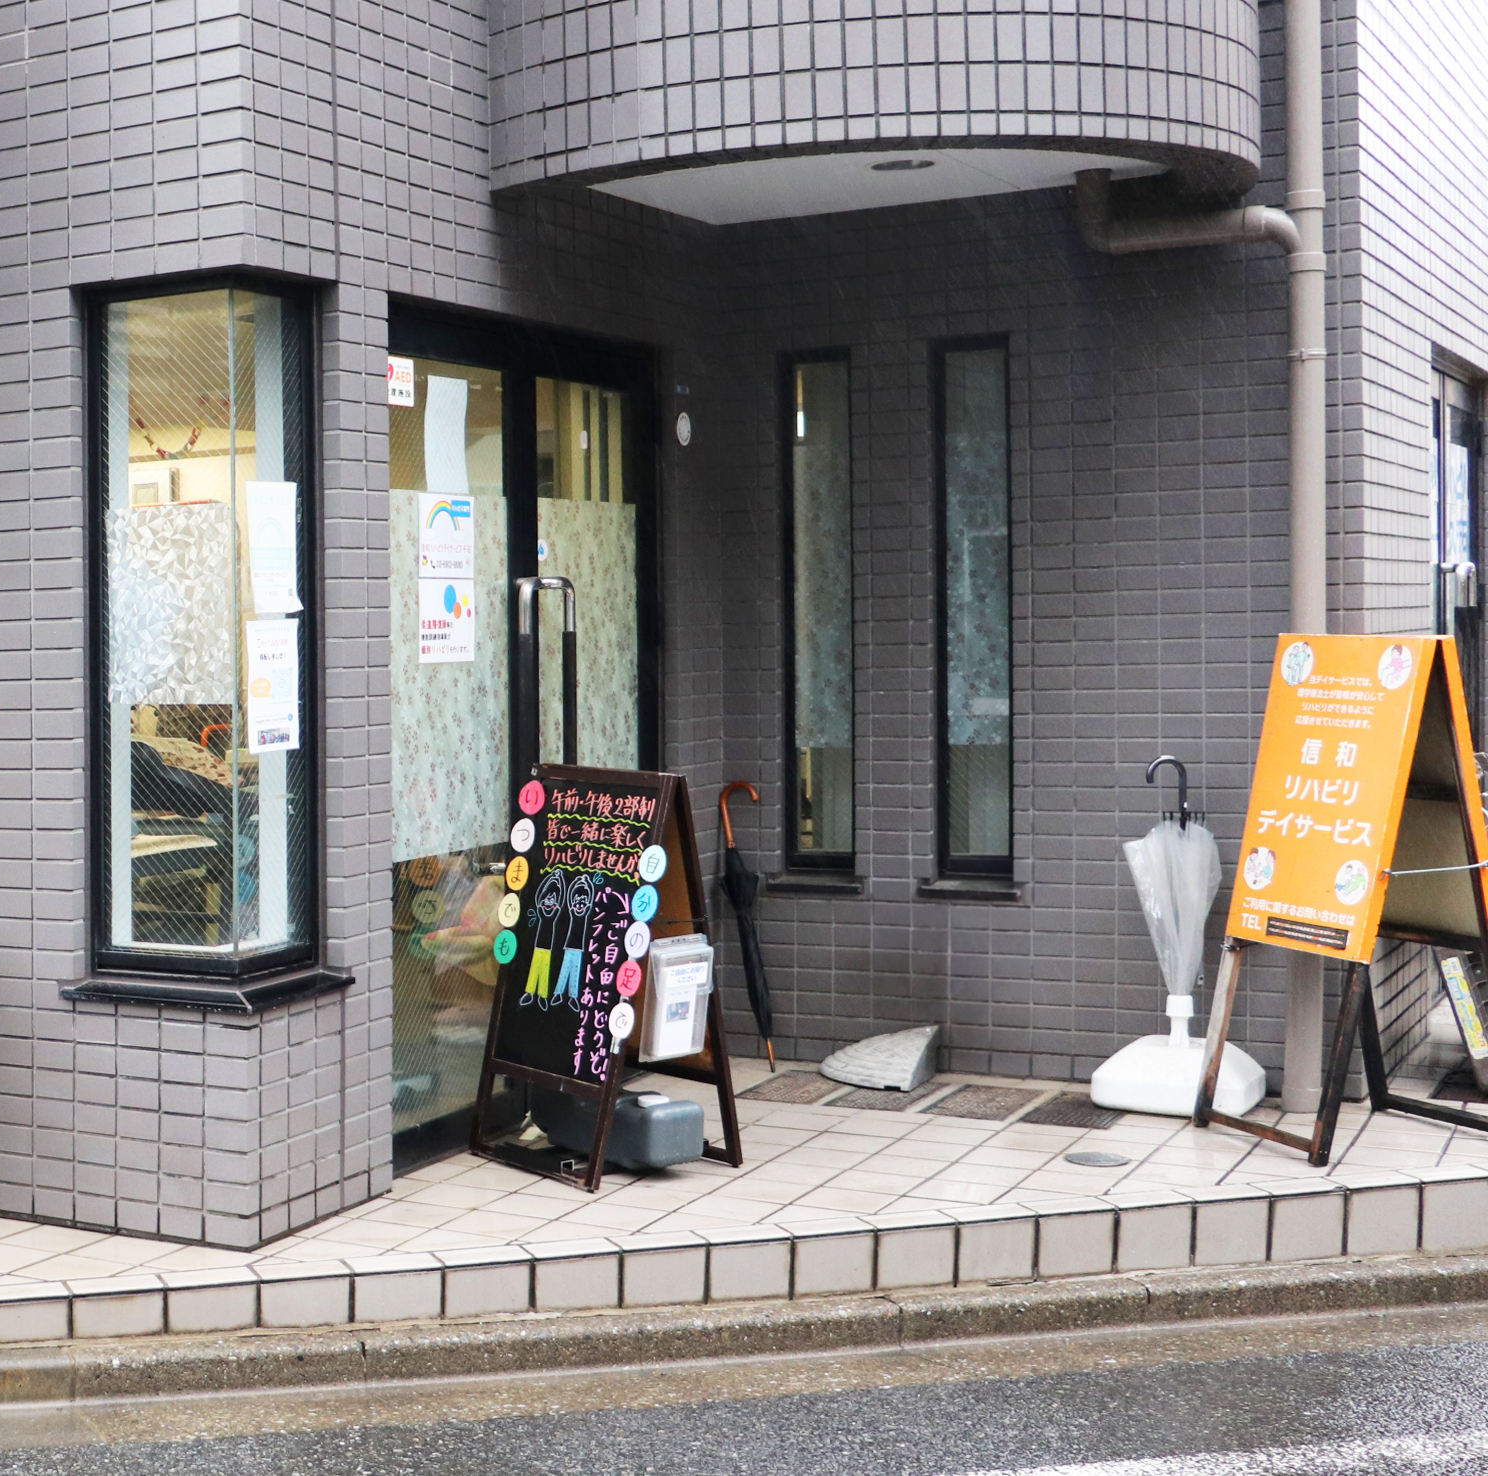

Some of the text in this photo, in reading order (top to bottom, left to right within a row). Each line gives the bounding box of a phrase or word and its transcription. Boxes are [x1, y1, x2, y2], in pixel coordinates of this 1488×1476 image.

[395, 371, 411, 383] AED
[388, 388, 411, 398] 置施設
[1302, 702, 1375, 715] リハビリができるように
[1295, 715, 1371, 729] 応援させていただきます。
[1285, 775, 1359, 805] リハビリ
[547, 819, 647, 850] 皆で一緒に楽しく
[1257, 810, 1371, 847] デイサービス
[1241, 912, 1262, 930] TEL
[1243, 896, 1356, 926] ご利用に関するお問い合わせは
[573, 886, 612, 1076] パンフレットあります
